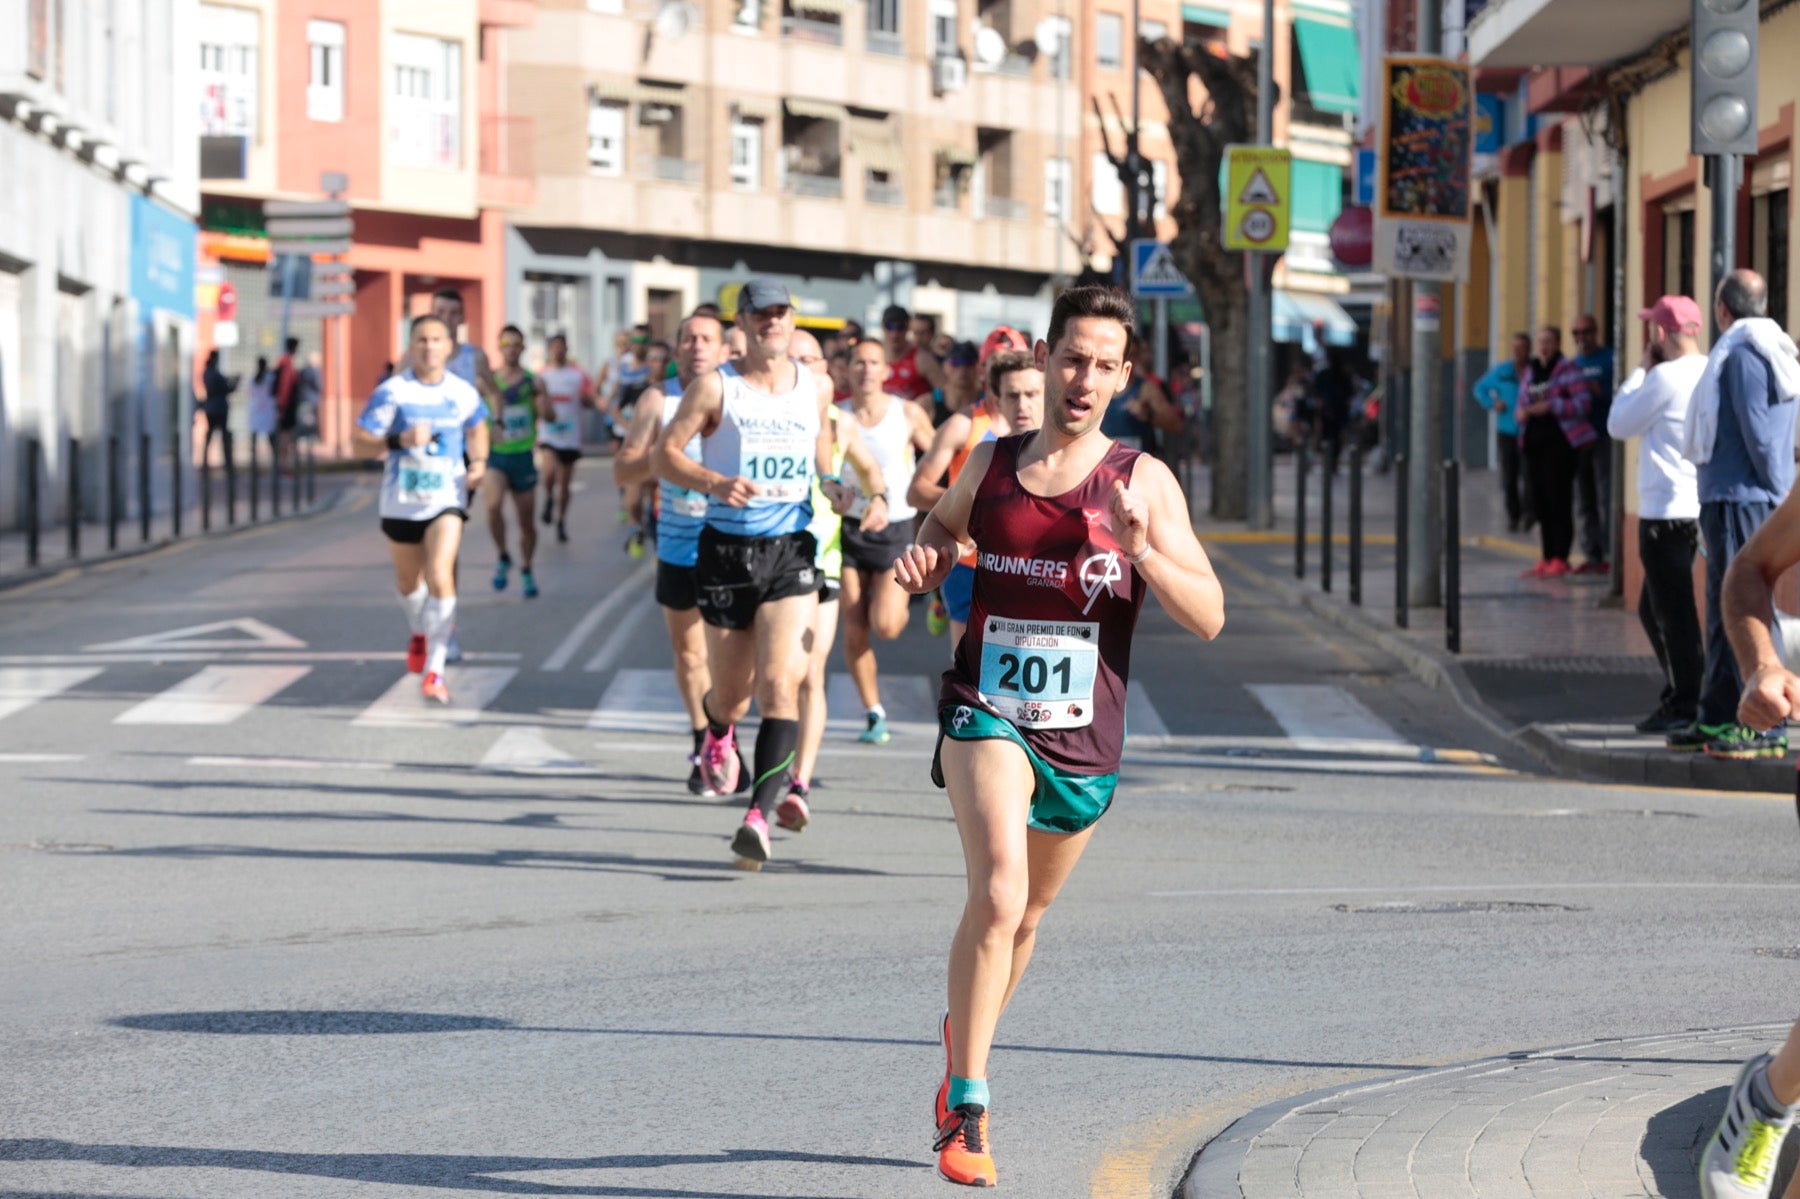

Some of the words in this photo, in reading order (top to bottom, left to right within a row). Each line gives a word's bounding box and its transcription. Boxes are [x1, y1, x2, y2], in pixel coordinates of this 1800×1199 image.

[747, 456, 807, 479] 1024
[1026, 577, 1066, 588] GRANADA
[1007, 622, 1025, 634] GRAN
[1026, 624, 1053, 636] PREMIO
[1055, 626, 1065, 636] DE
[998, 653, 1072, 694] 201
